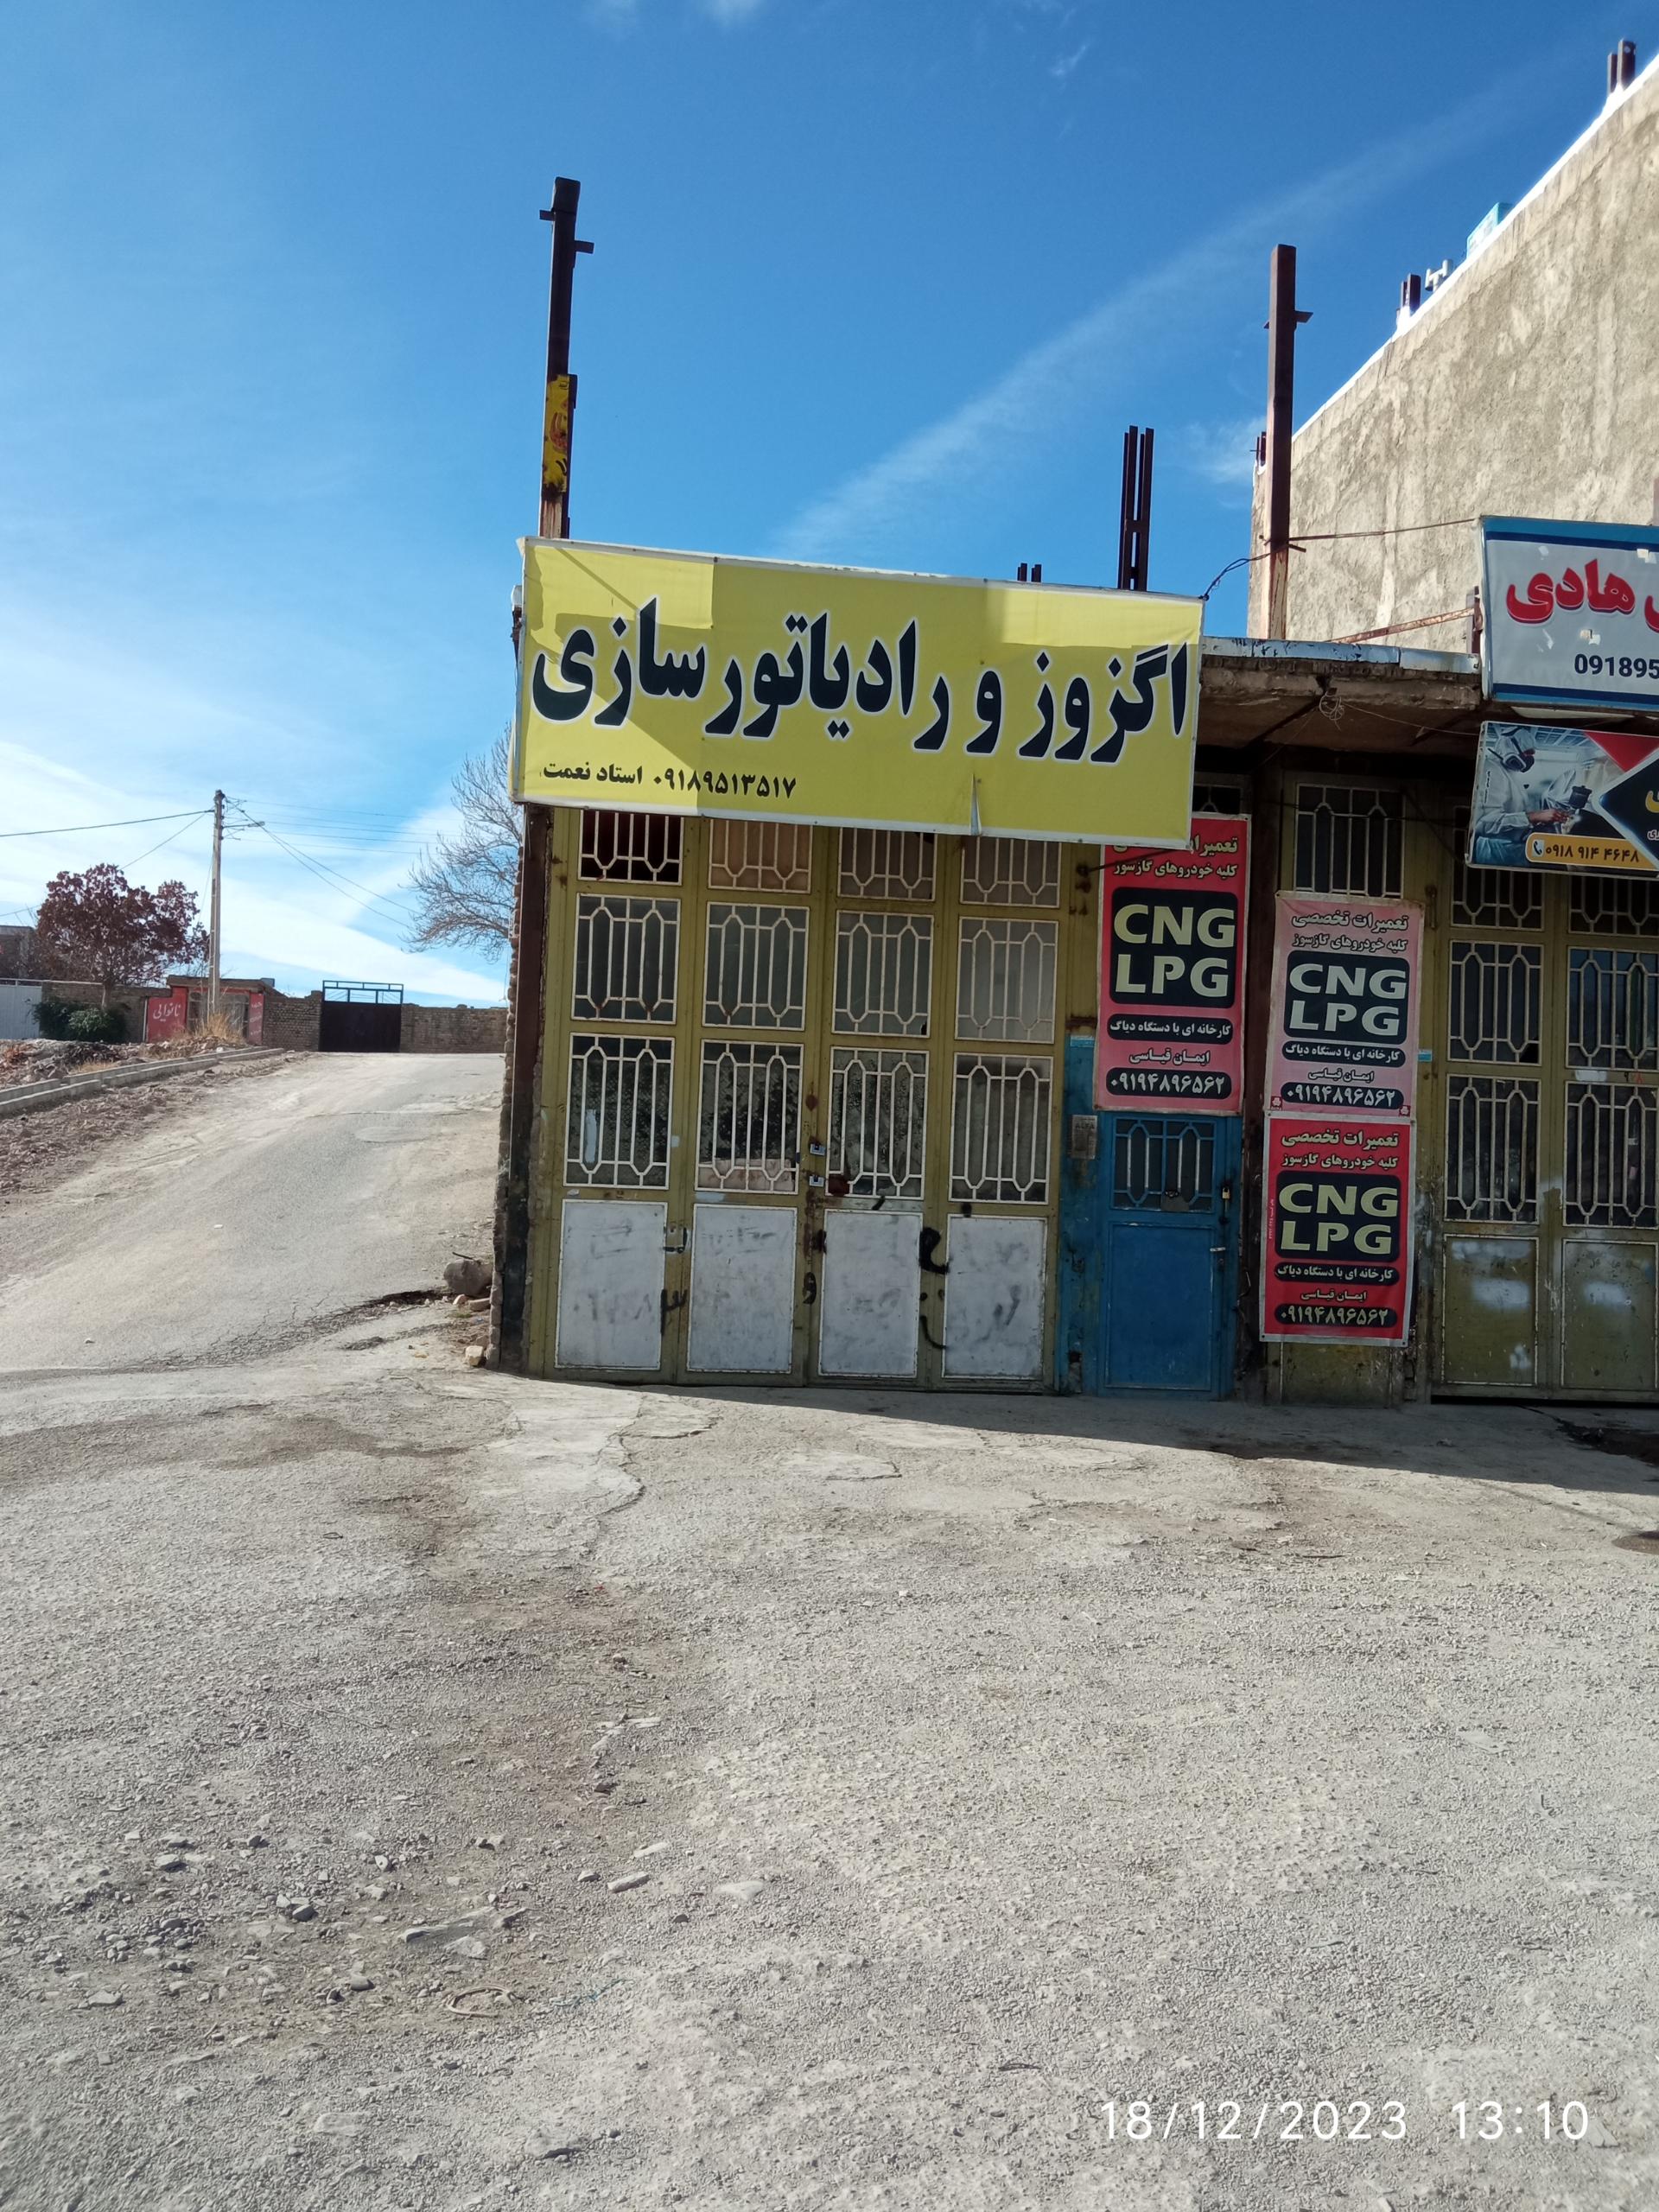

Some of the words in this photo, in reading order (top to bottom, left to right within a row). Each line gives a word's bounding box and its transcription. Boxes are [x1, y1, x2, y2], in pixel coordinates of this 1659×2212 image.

[1506, 558, 1637, 626] هادی
[1574, 653, 1659, 680] 091895
[965, 669, 1002, 755] و
[1019, 642, 1190, 764] اگزوز
[543, 761, 592, 781] نعمت
[596, 763, 644, 785] استاد
[653, 766, 797, 799] ۰۹۱۸۹۵۱۳۵۱۷
[1188, 835, 1238, 857] تعمیرا
[1154, 861, 1213, 879] خودروهای
[1216, 864, 1238, 880] کلیه
[1114, 903, 1236, 950] CNG
[1292, 910, 1351, 928] تخصصی
[1352, 912, 1409, 933] تعمیرات
[1331, 934, 1385, 952] خودروهای
[1387, 938, 1408, 954] کلیه
[1115, 953, 1230, 998] LPG
[1289, 963, 1407, 1000] CNG
[1137, 1020, 1171, 1033] دستگاه
[1289, 1000, 1400, 1037] LPG
[1173, 1021, 1180, 1036] با
[1181, 1022, 1195, 1037] ای
[1197, 1023, 1231, 1039] کارخانه
[1173, 1048, 1211, 1066] ایمان
[1311, 1046, 1342, 1057] دستگاه
[1344, 1046, 1351, 1060] با
[1351, 1047, 1365, 1061] ای
[1367, 1049, 1401, 1063] کارخانه
[1110, 1072, 1225, 1095] ۰۹۱۹۴۸۹۶۵۶۲
[1343, 1069, 1375, 1084] ایمان
[1287, 1084, 1396, 1108] ۰۹۱۹۴۸۹۶۵۶۲
[1281, 1128, 1340, 1147] تخصصی
[1343, 1130, 1399, 1151] تعمیرات
[1321, 1154, 1376, 1170] خودروهای
[1378, 1155, 1398, 1171] کلیه
[1279, 1183, 1399, 1218] CNG
[1281, 1220, 1392, 1255] LPG
[1303, 1265, 1334, 1277] دستگاه
[1336, 1267, 1344, 1280] با
[1345, 1268, 1357, 1281] ای
[1359, 1267, 1394, 1282] کارخانه
[1337, 1289, 1368, 1304] ایمان
[1281, 1305, 1389, 1326] ۰۹۱۹۴۸۹۶۵۶۲
